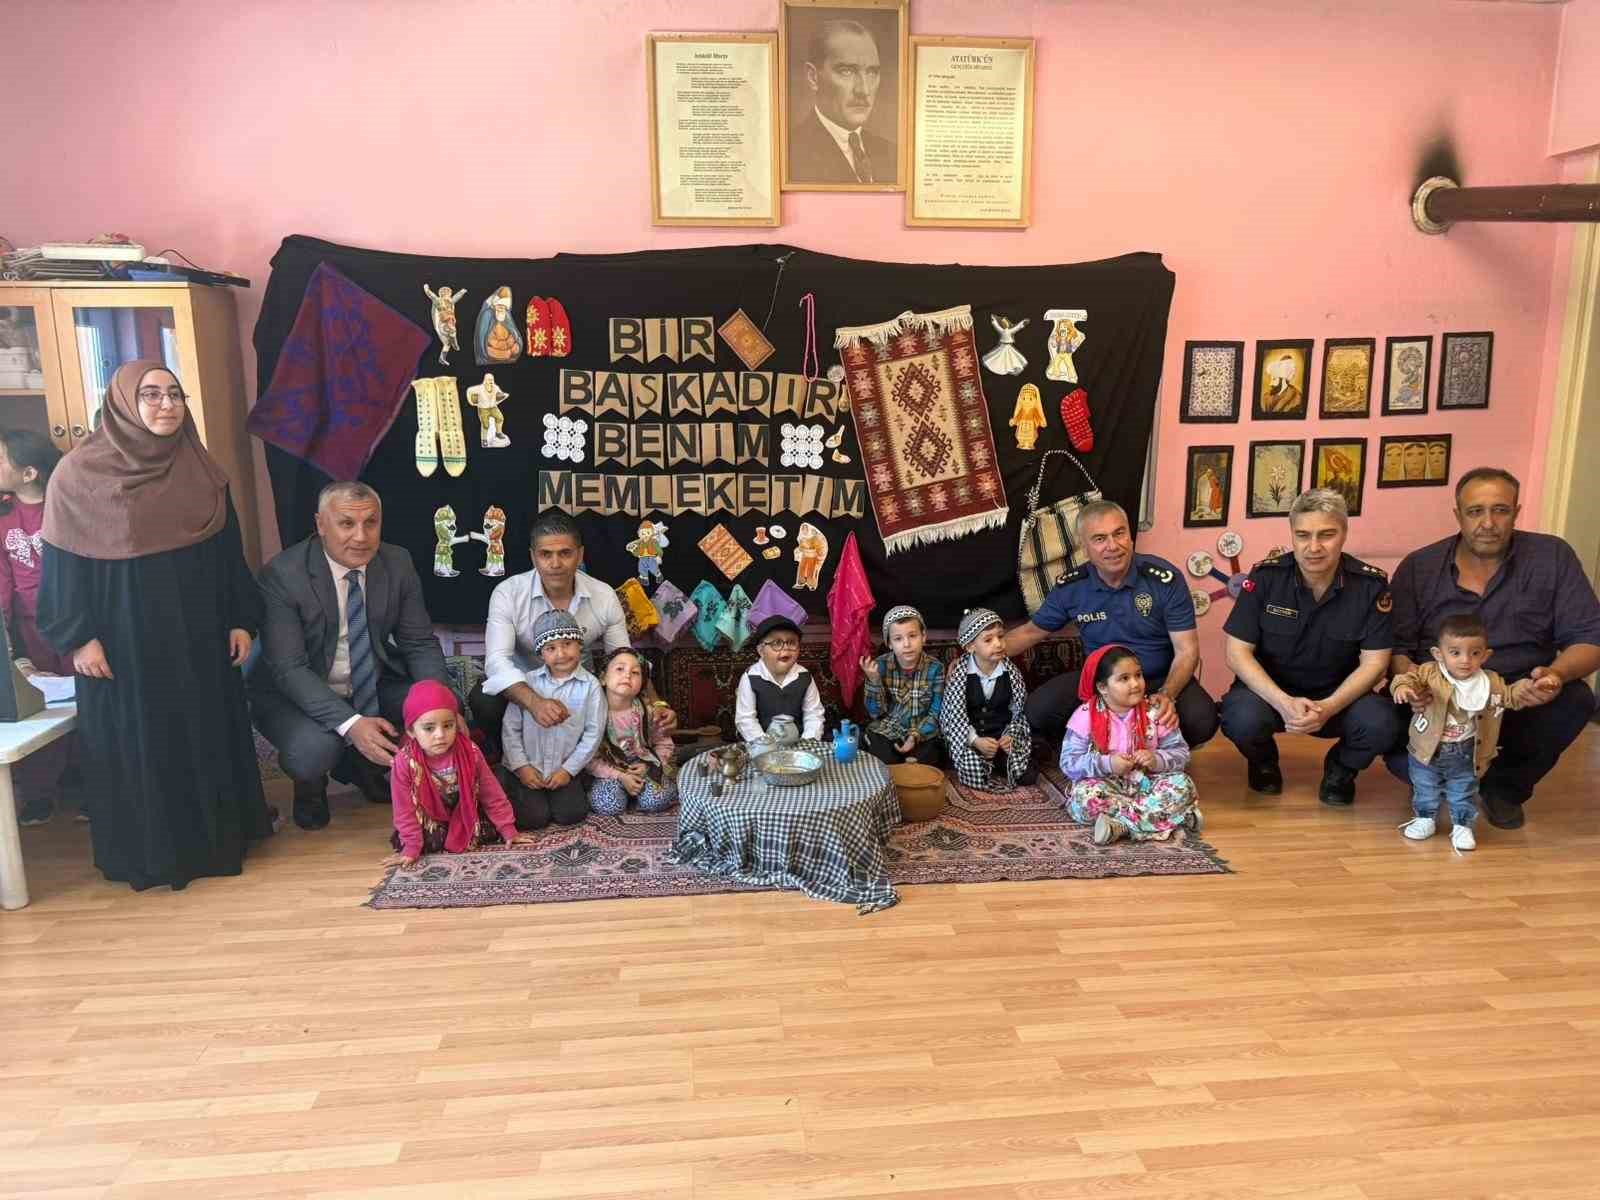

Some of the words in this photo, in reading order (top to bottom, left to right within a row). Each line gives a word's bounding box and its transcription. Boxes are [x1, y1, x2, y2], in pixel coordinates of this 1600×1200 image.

[613, 318, 714, 355] BİR
[598, 423, 769, 459] BENİM
[540, 471, 865, 513] MEMLEKETİM
